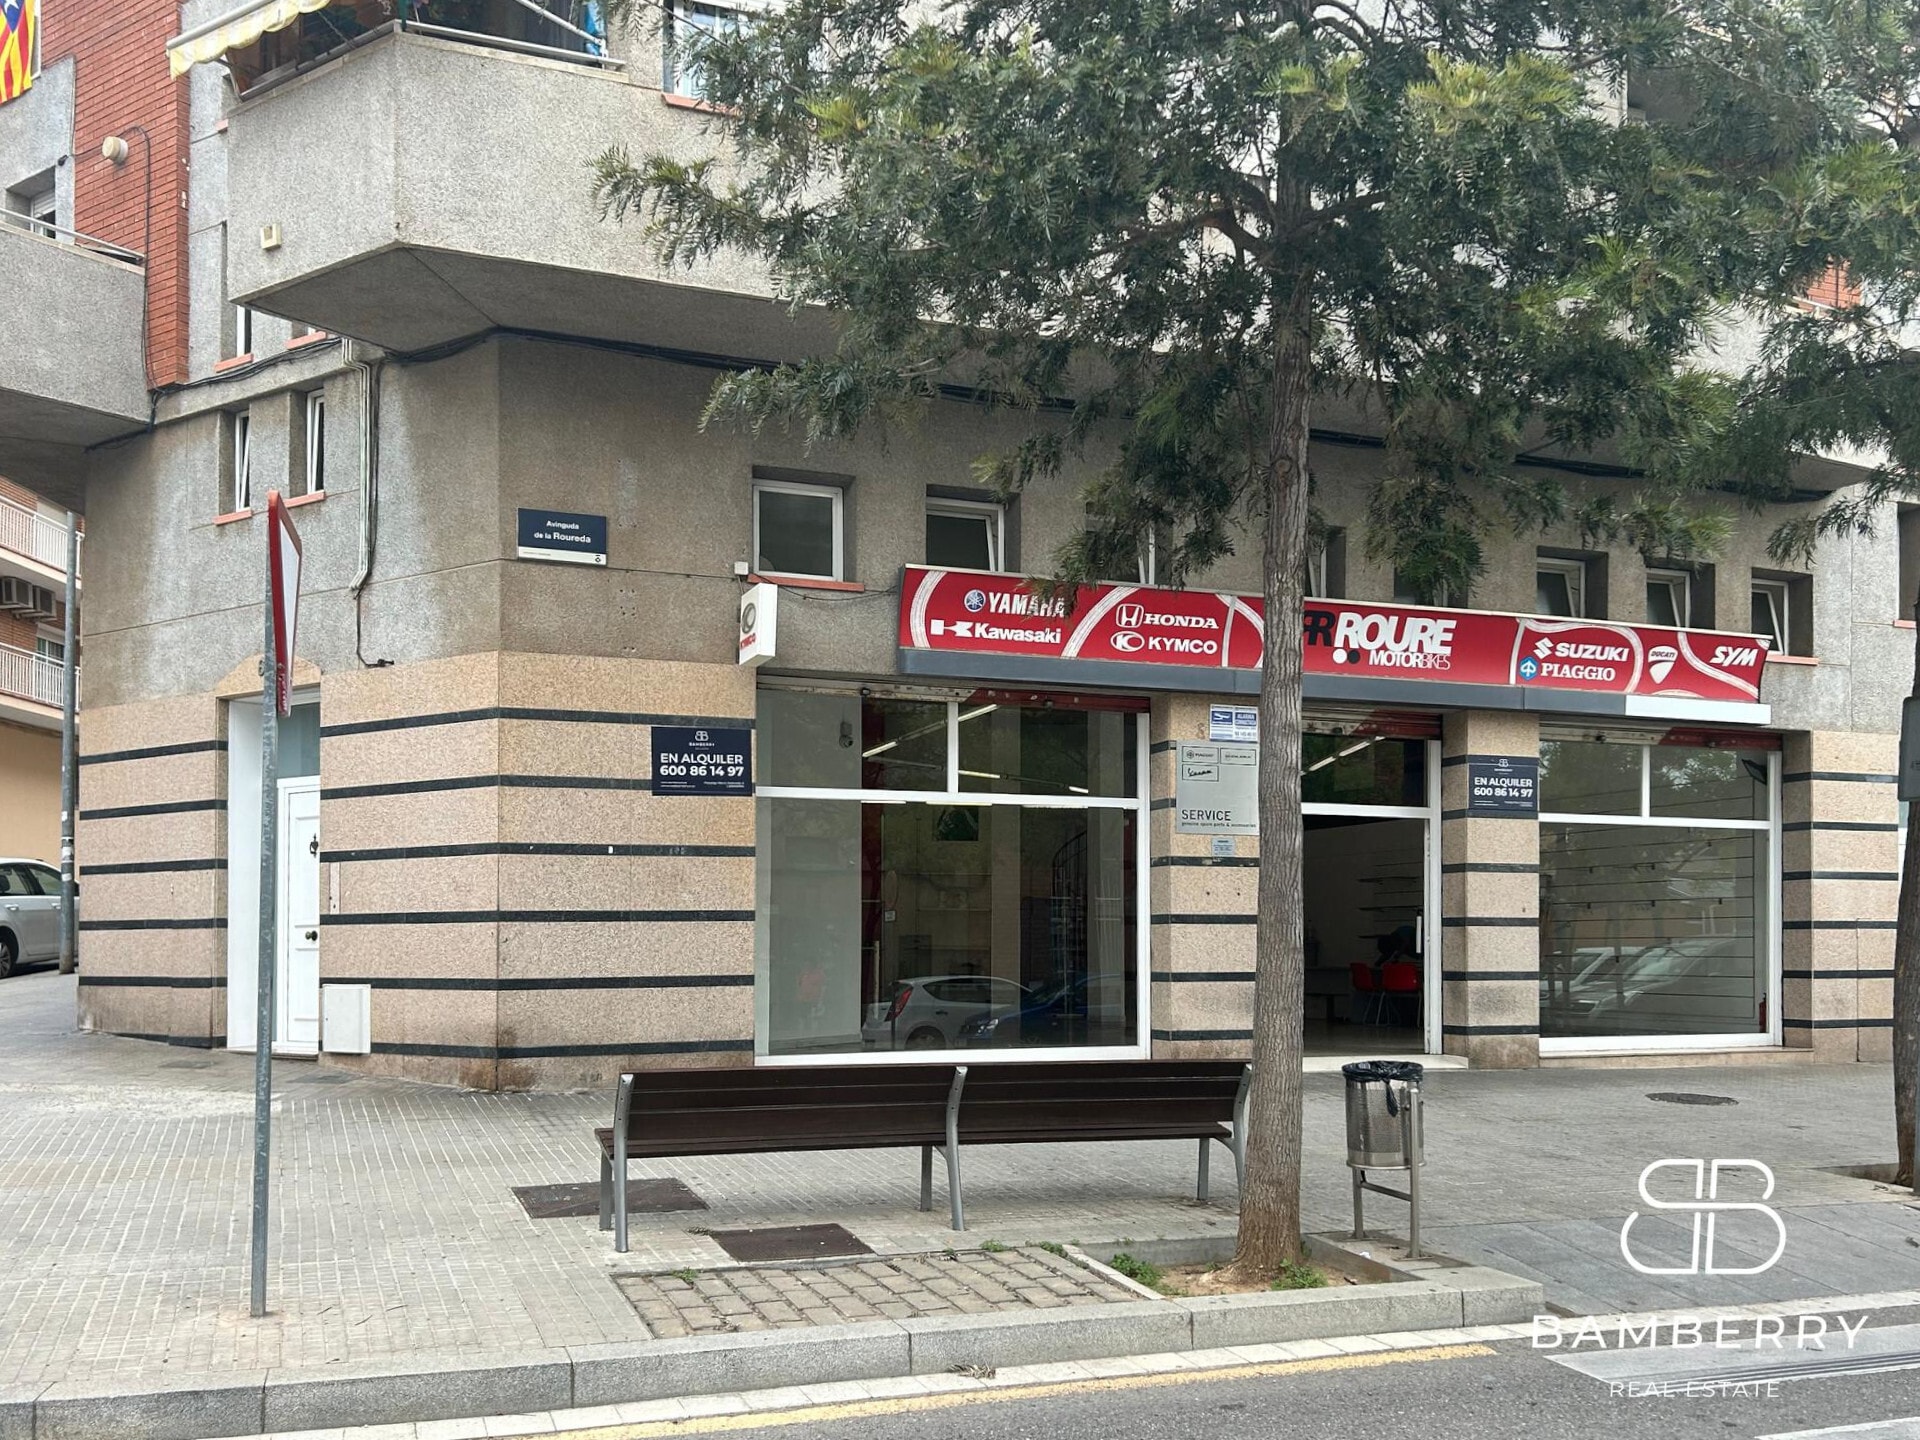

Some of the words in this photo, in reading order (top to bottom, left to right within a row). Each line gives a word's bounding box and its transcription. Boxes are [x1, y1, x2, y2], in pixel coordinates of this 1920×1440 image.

[546, 520, 580, 530] Avinguda
[553, 532, 592, 543] Roureda
[1143, 613, 1219, 629] HONDA
[974, 622, 1062, 644] Kawasaki
[1334, 612, 1457, 655] ROURE
[1148, 636, 1218, 655] KYMCO
[1554, 642, 1630, 662] SUZUKI
[1368, 650, 1451, 670] MOTORBIKES
[1650, 650, 1676, 658] DUCATI
[1709, 646, 1759, 667] SYM
[1540, 662, 1616, 682] PIAGGIO
[660, 753, 679, 763] EN
[681, 753, 744, 765] ALQUILER
[660, 765, 686, 776] 600
[689, 766, 707, 776] 86
[709, 766, 725, 776] 14
[727, 766, 744, 777] 97
[1474, 777, 1487, 785] EN
[1488, 777, 1533, 787] ALQUILER
[1474, 787, 1493, 796] 600
[1494, 787, 1507, 796] 86
[1508, 788, 1519, 797] 14
[1520, 788, 1533, 798] 97
[1181, 809, 1231, 821] SERVICE
